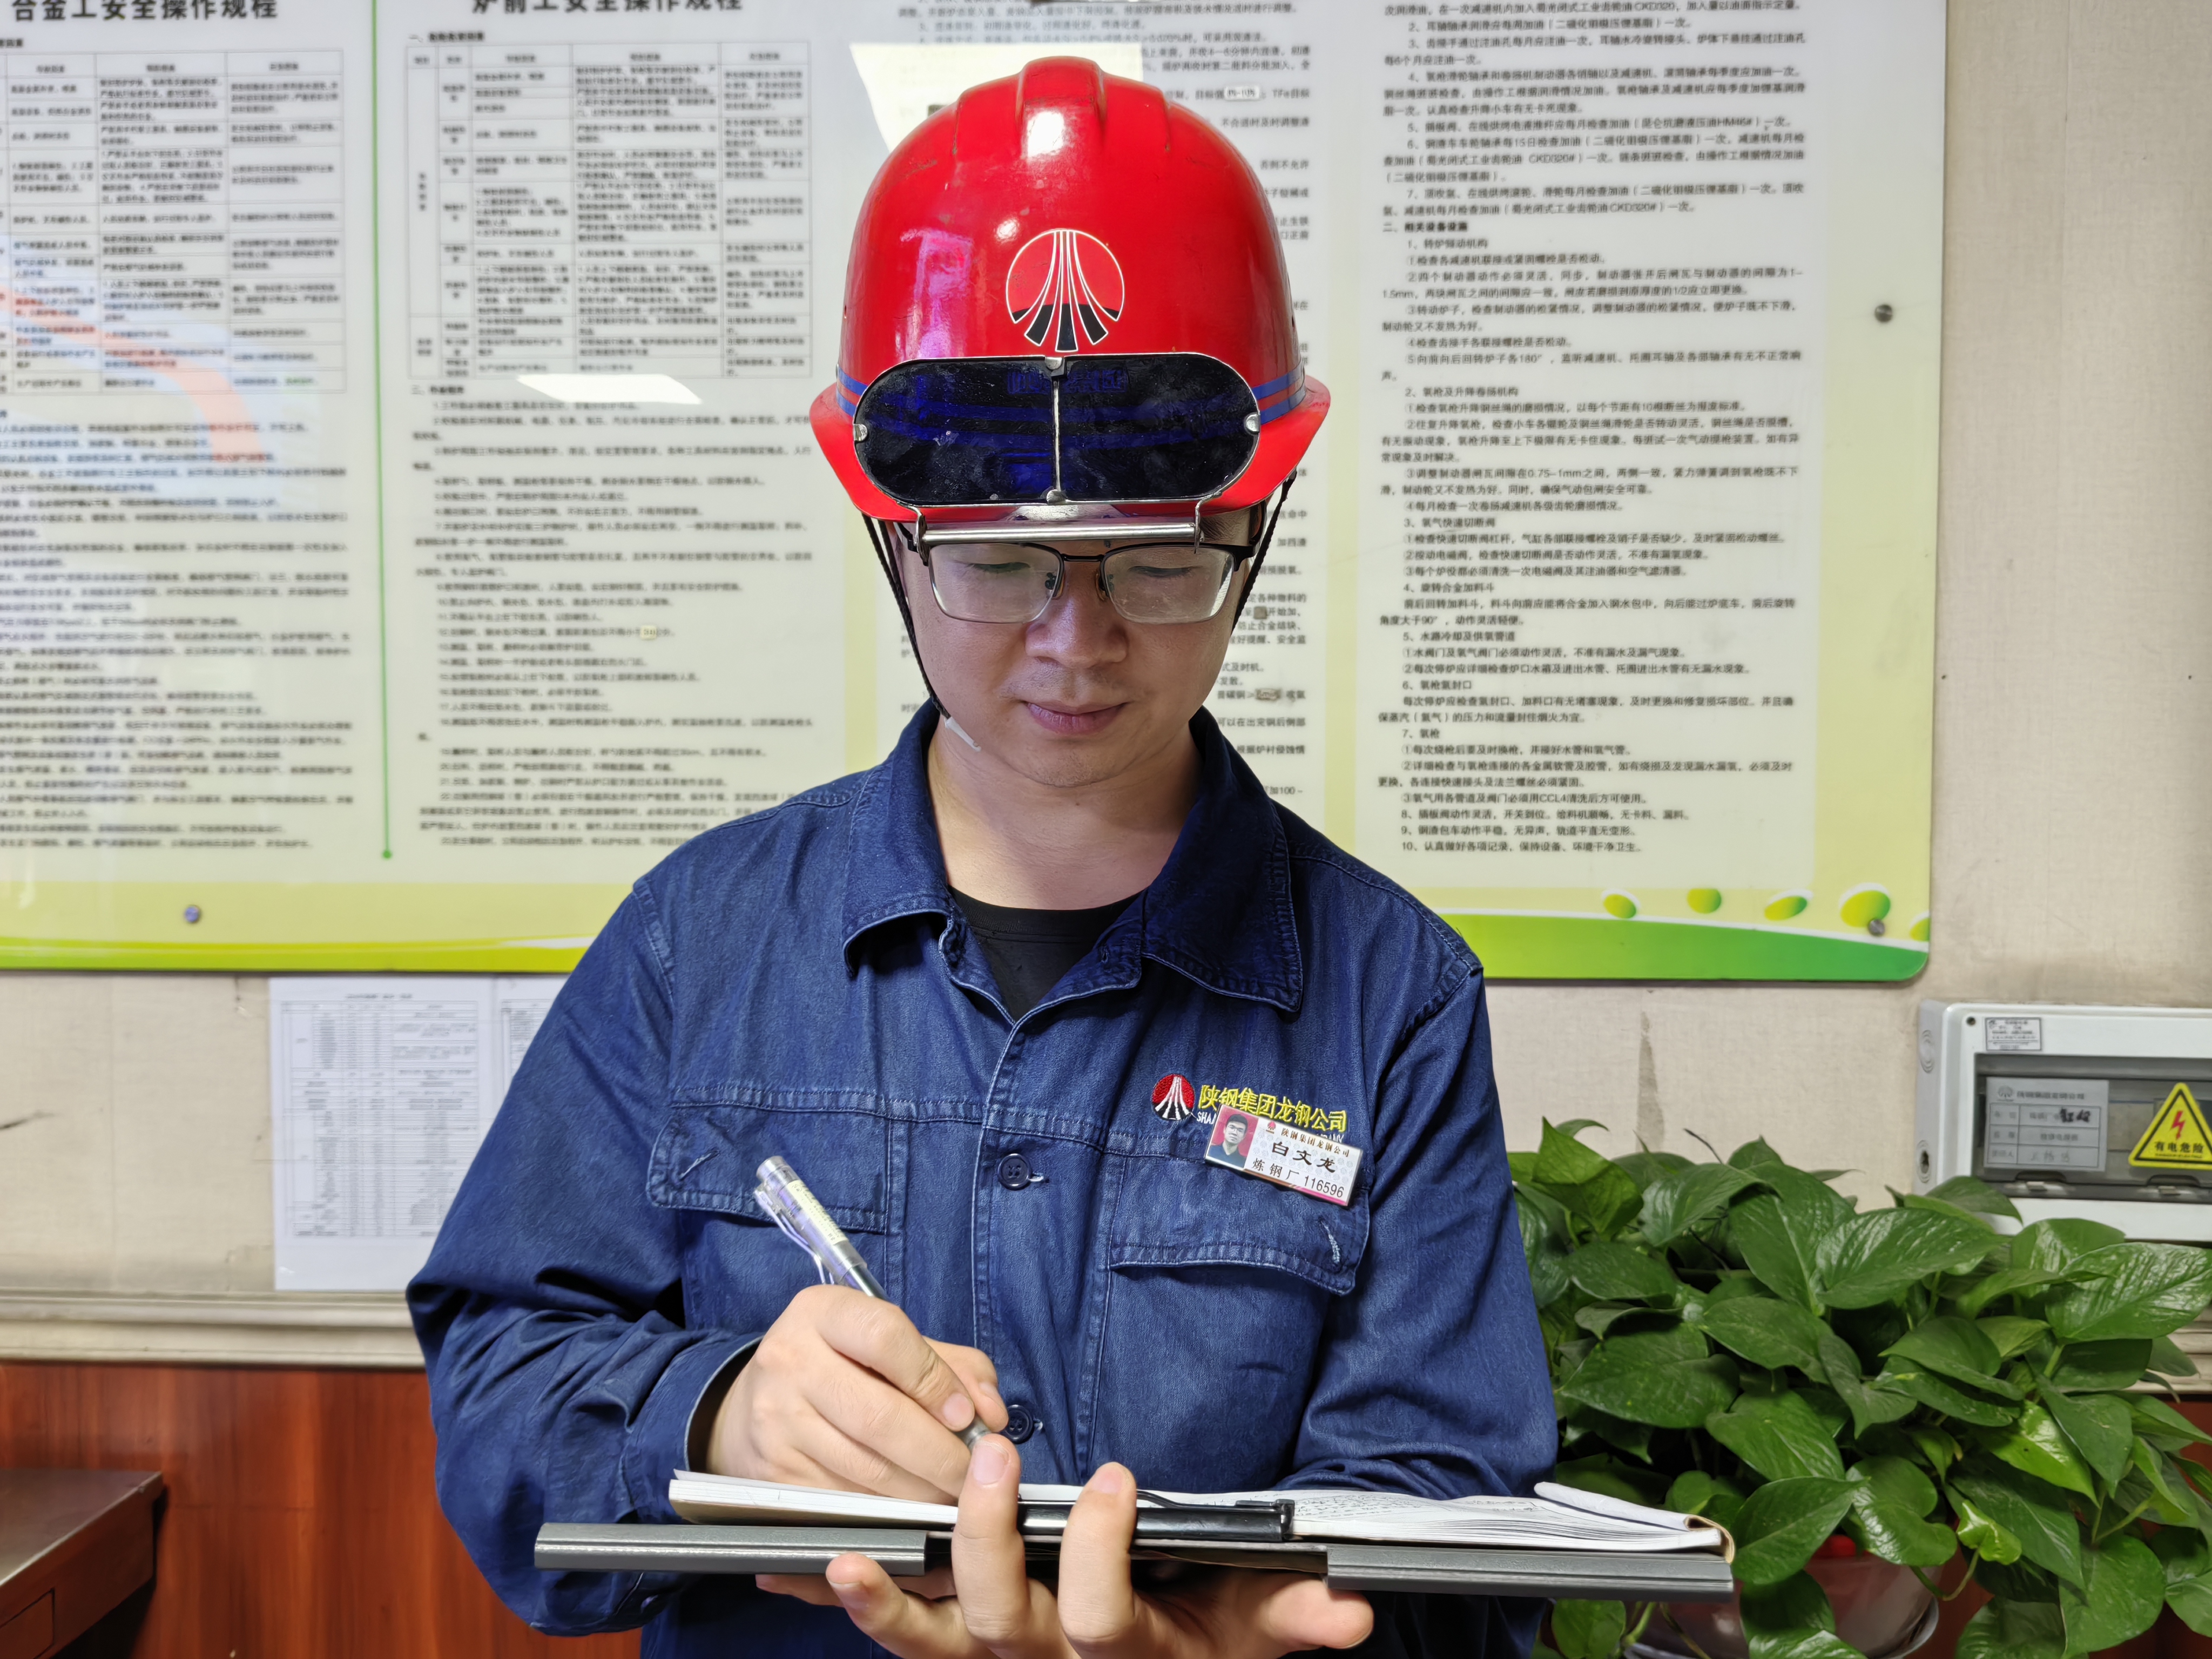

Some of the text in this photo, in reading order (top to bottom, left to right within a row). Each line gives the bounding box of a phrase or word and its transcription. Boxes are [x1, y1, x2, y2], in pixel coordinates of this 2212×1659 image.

[11, 0, 279, 22] 合金工安全操作规程
[1408, 238, 1488, 249] 1、转炉倾动机构
[1404, 517, 1495, 528] 3、氧气快速切断阀
[1404, 582, 1495, 593] 4、旋转合金加料斗
[1217, 676, 1243, 686] 发散。
[1402, 729, 1440, 739] 7、氧枪
[1198, 1084, 1347, 1132] 陕钢集团龙钢公司
[1281, 1127, 1350, 1157] 陕钢集团龙钢公司
[2154, 1141, 2203, 1153] 有电危险
[1272, 1141, 1336, 1173] 白文龙
[1253, 1158, 1344, 1198] 炼钢厂 116596
